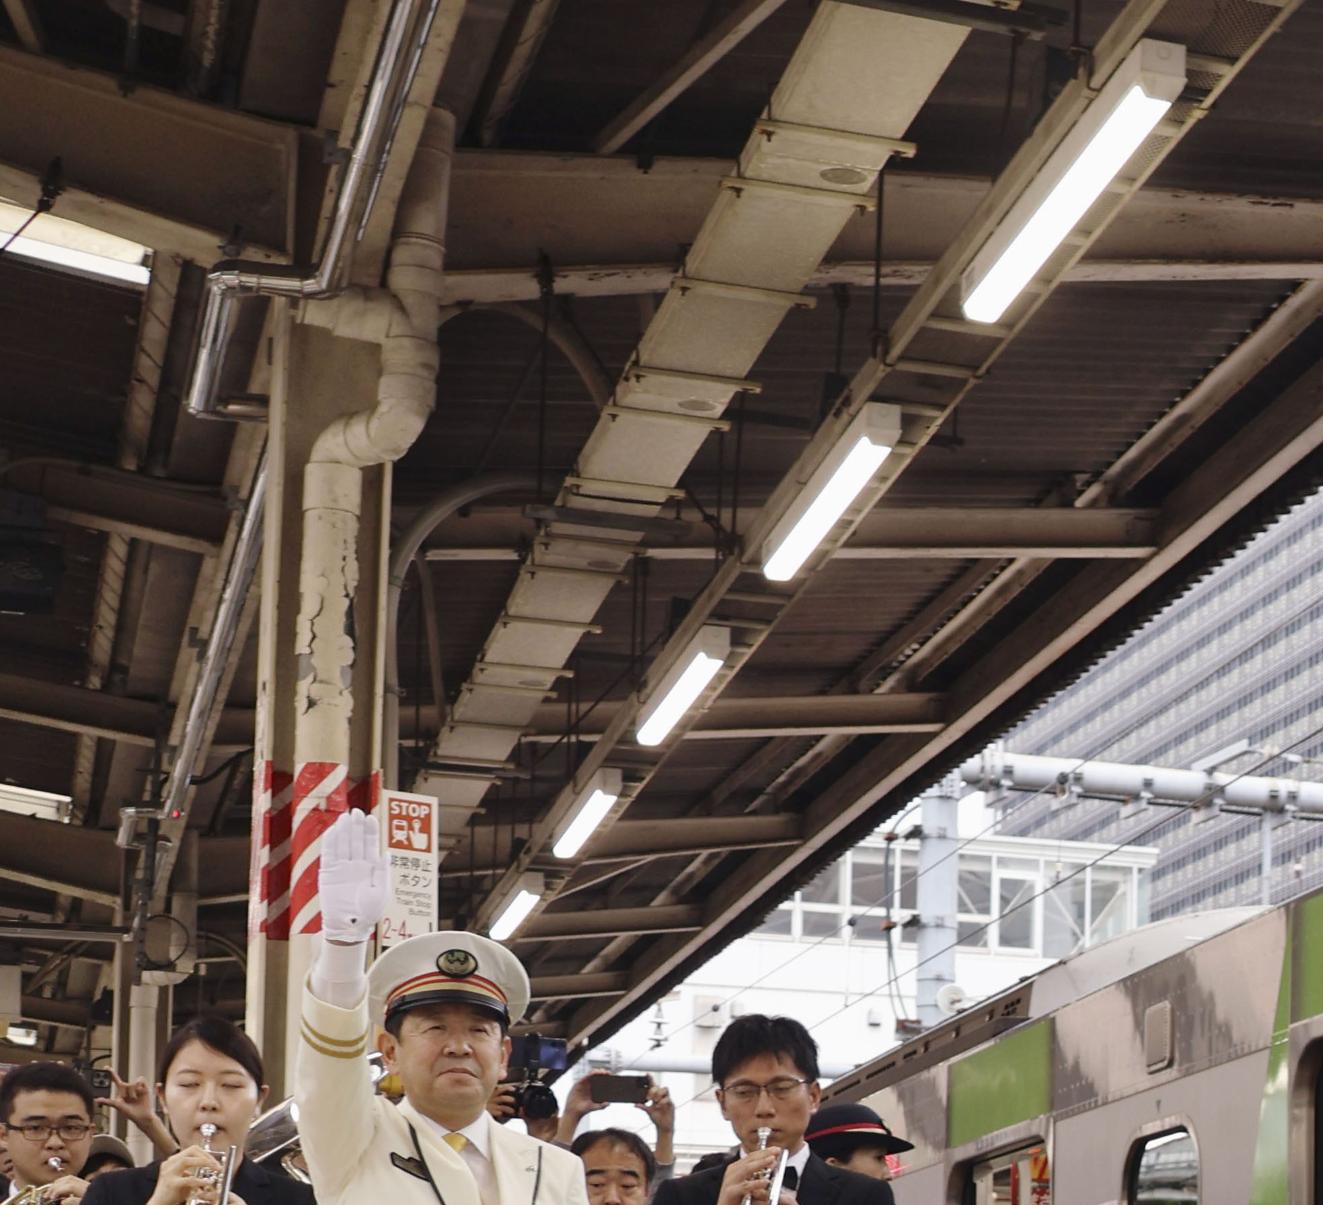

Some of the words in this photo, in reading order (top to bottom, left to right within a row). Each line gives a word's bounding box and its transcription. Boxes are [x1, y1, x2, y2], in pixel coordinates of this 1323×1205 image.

[390, 801, 430, 818] STOP
[400, 872, 432, 888] ボタン
